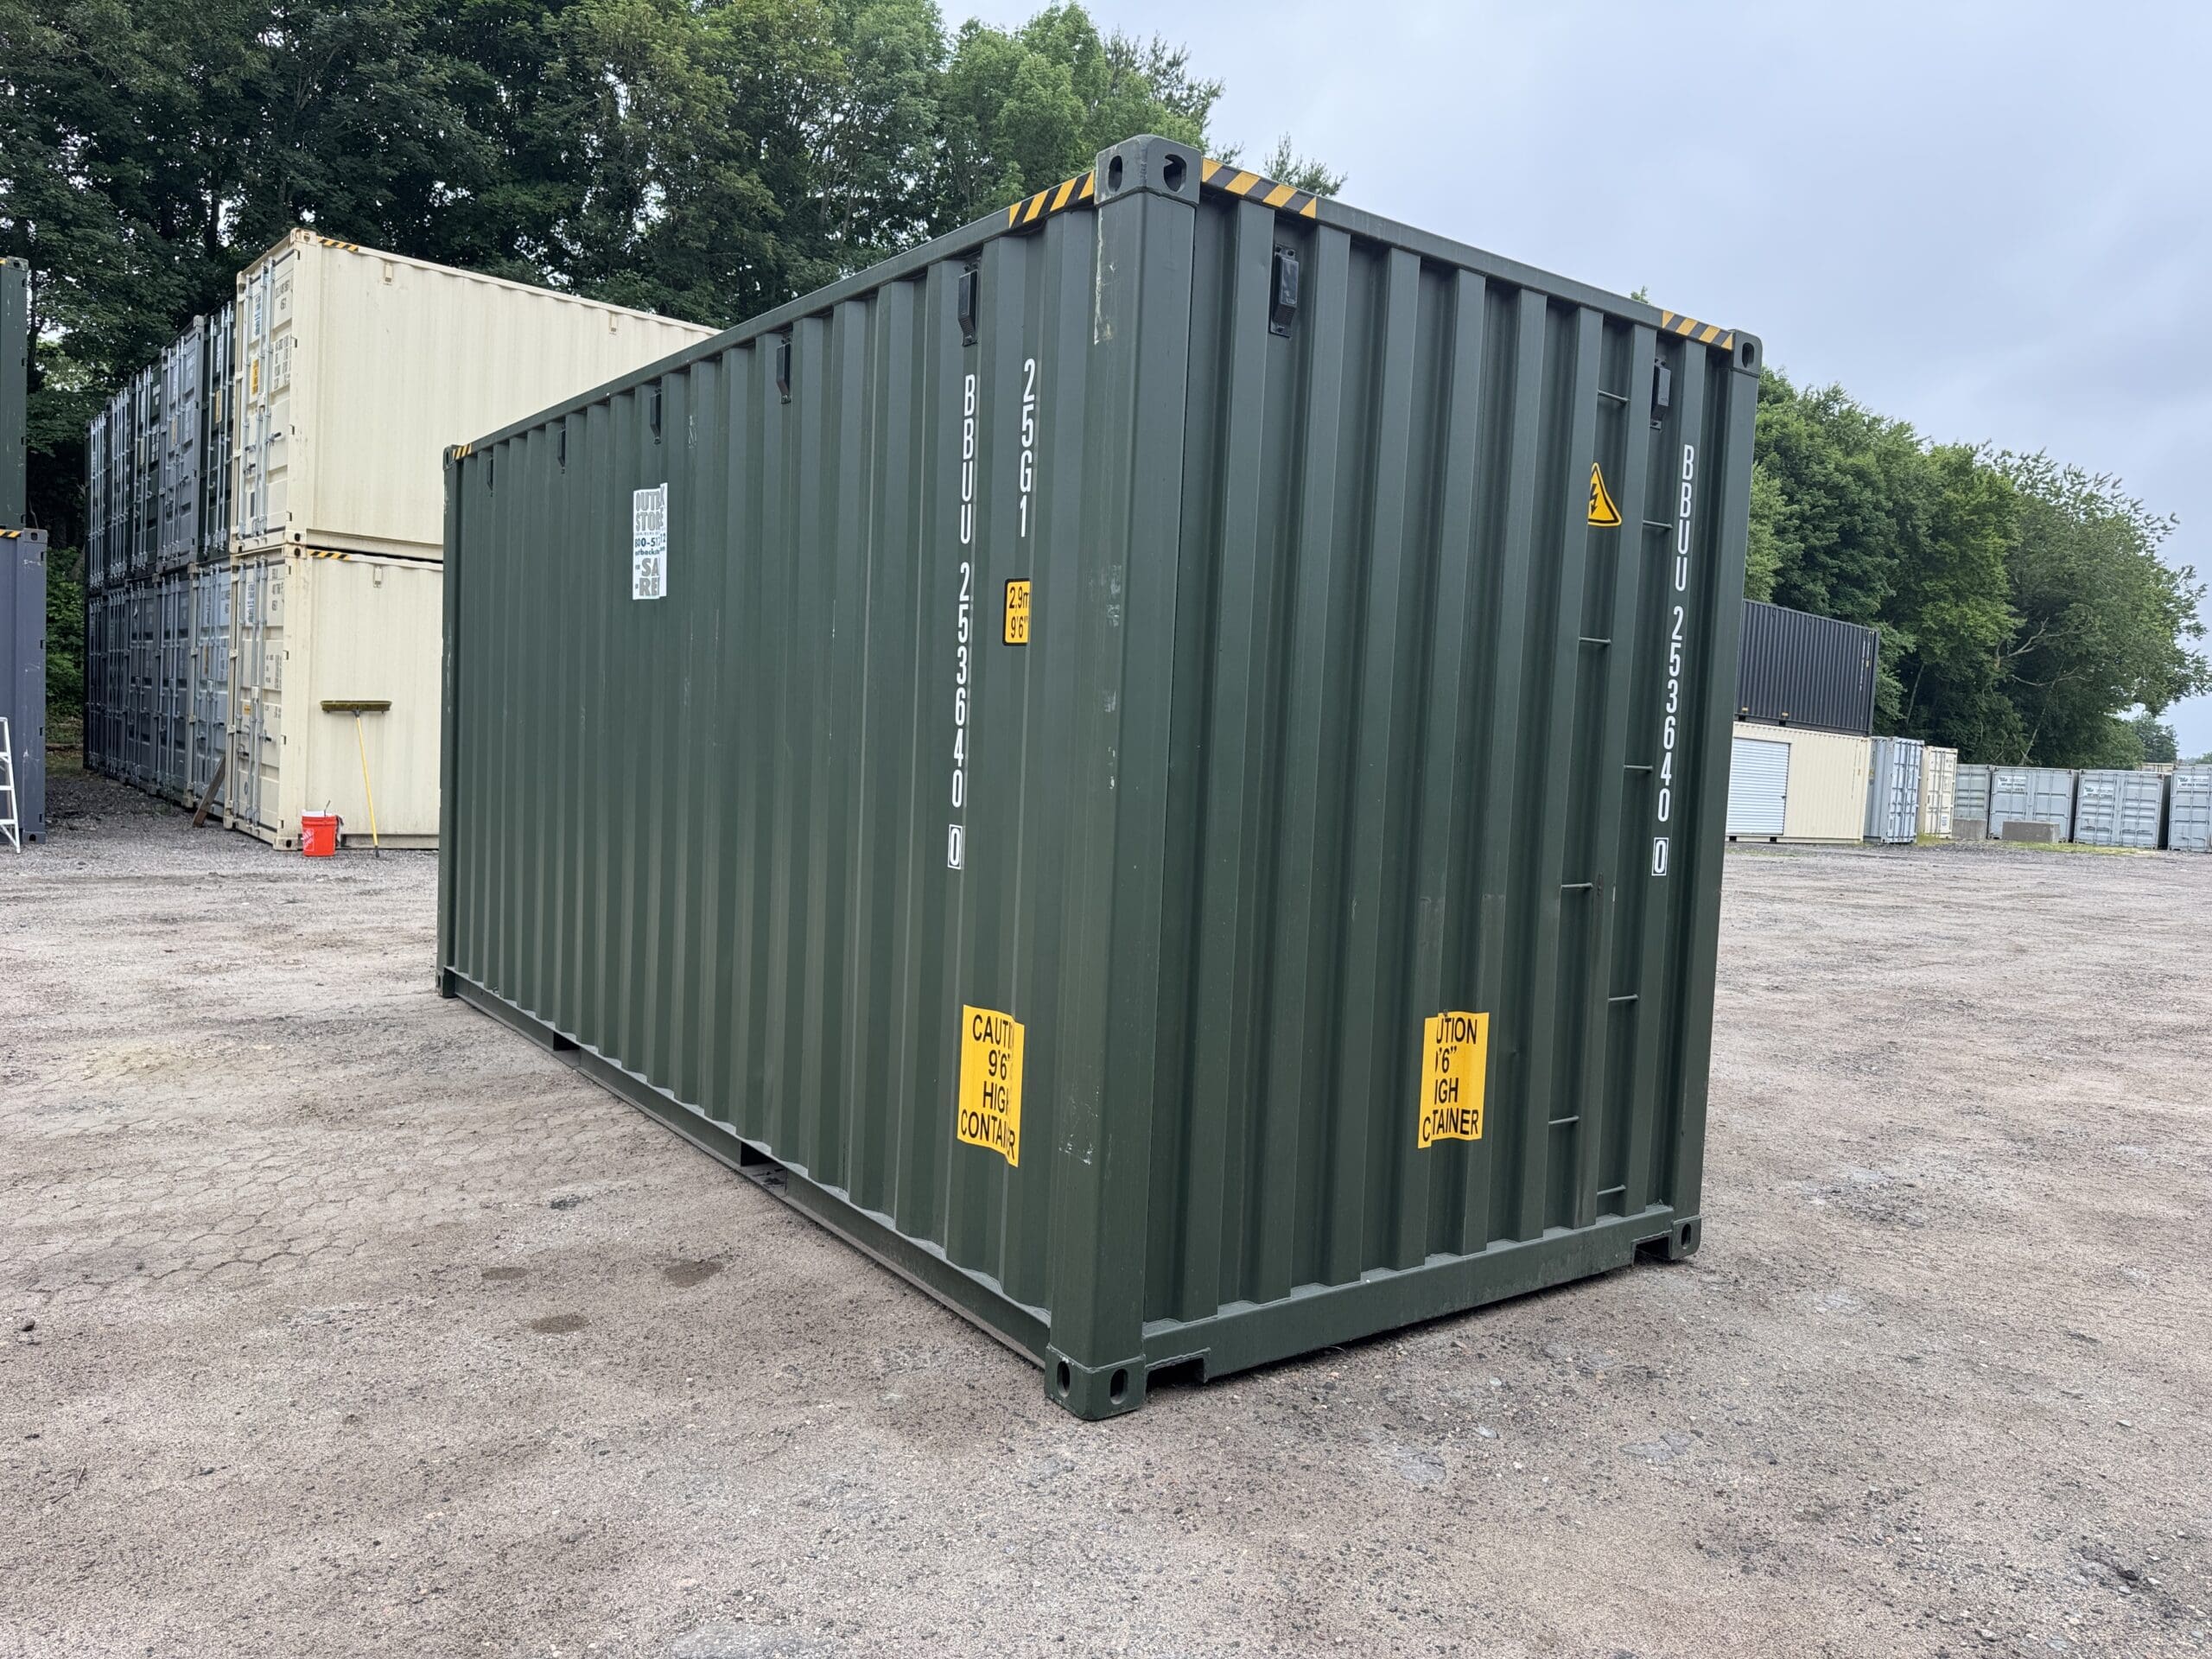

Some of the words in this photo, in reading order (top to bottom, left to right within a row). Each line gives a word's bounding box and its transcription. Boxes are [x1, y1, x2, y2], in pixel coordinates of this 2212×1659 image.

[961, 374, 976, 544] BBUU
[1020, 358, 1036, 537] 25G1
[1675, 444, 1694, 592] BBUU
[952, 562, 969, 808] 253640
[1657, 606, 1683, 822] 253640
[950, 827, 962, 867] 0
[1653, 839, 1668, 874] 0
